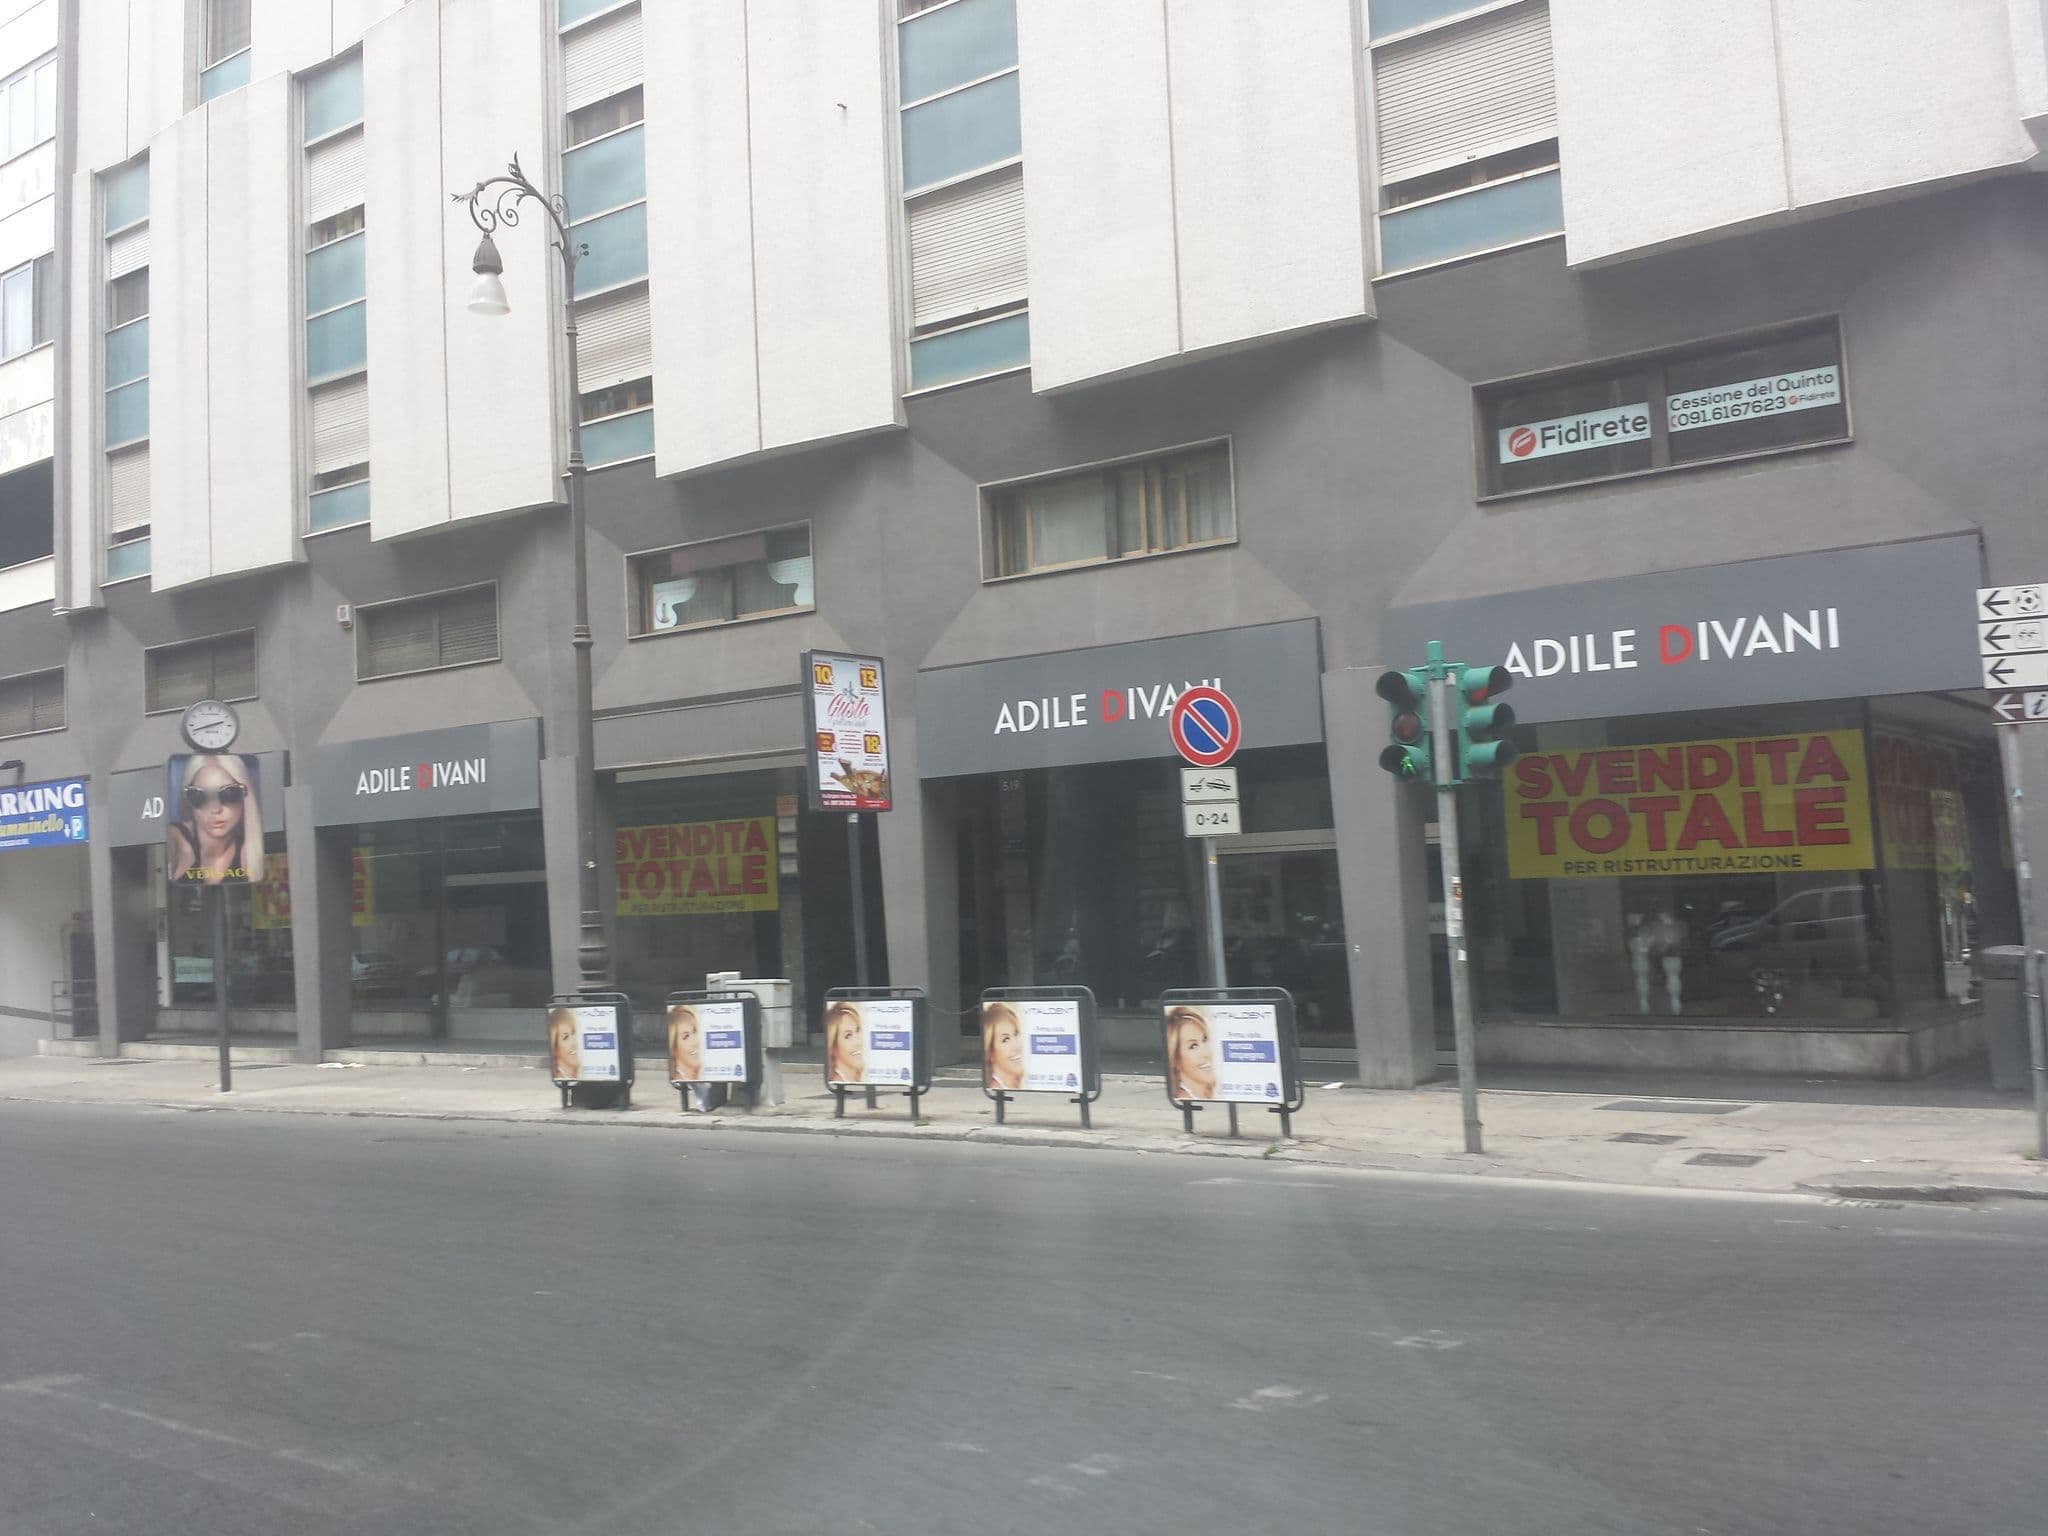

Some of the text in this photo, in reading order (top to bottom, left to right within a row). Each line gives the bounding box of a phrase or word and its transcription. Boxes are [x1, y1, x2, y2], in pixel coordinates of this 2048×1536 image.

[1670, 372, 1834, 411] Cessione del Quinto
[1799, 391, 1835, 401] Fidirete
[1678, 396, 1786, 427] 091.6167623
[1540, 414, 1648, 448] Fidirete
[1503, 607, 1841, 678] ADILE DIVANI
[993, 677, 1222, 734] ADILE DIVA
[355, 758, 486, 795] ADILE DIVANI
[1516, 735, 1851, 799] SVENDITA
[0, 783, 85, 816] RKING
[1196, 812, 1229, 826] 0-24
[1520, 786, 1851, 856] TOTALE
[616, 820, 769, 861] SVENDITA
[616, 855, 769, 901] TOTALE
[1563, 853, 1803, 875] PER RISTRUTTURAZIONE
